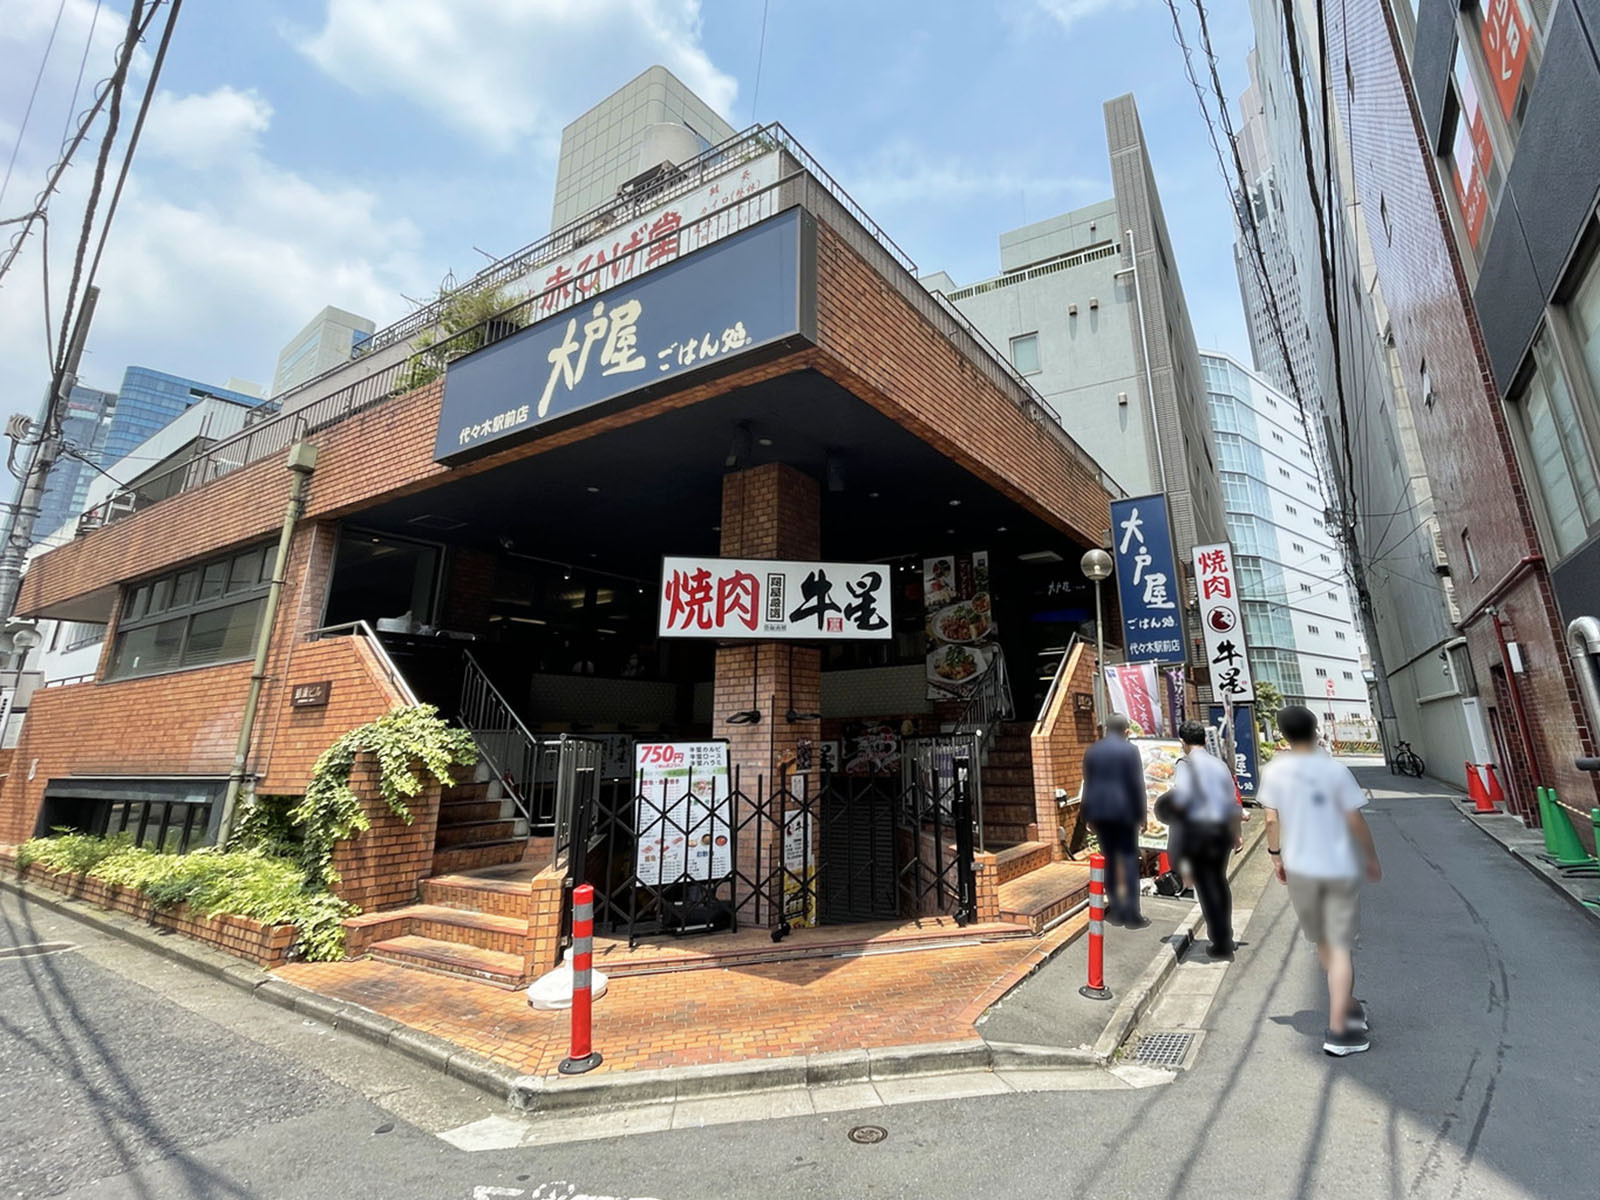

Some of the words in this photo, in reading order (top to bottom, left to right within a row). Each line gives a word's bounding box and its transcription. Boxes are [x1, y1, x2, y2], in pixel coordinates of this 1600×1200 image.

[539, 211, 682, 310] 赤ひげ堂
[537, 299, 646, 418] 大戸屋
[658, 320, 748, 371] ごはん処
[459, 404, 530, 446] 代々木駅前店
[1119, 507, 1176, 610] 大戸屋
[1198, 549, 1232, 600] 焼肉
[665, 567, 760, 631] 焼肉
[1127, 615, 1176, 630] ごはん処
[1129, 639, 1181, 656] 代々木駅前店
[639, 744, 685, 764] 750円
